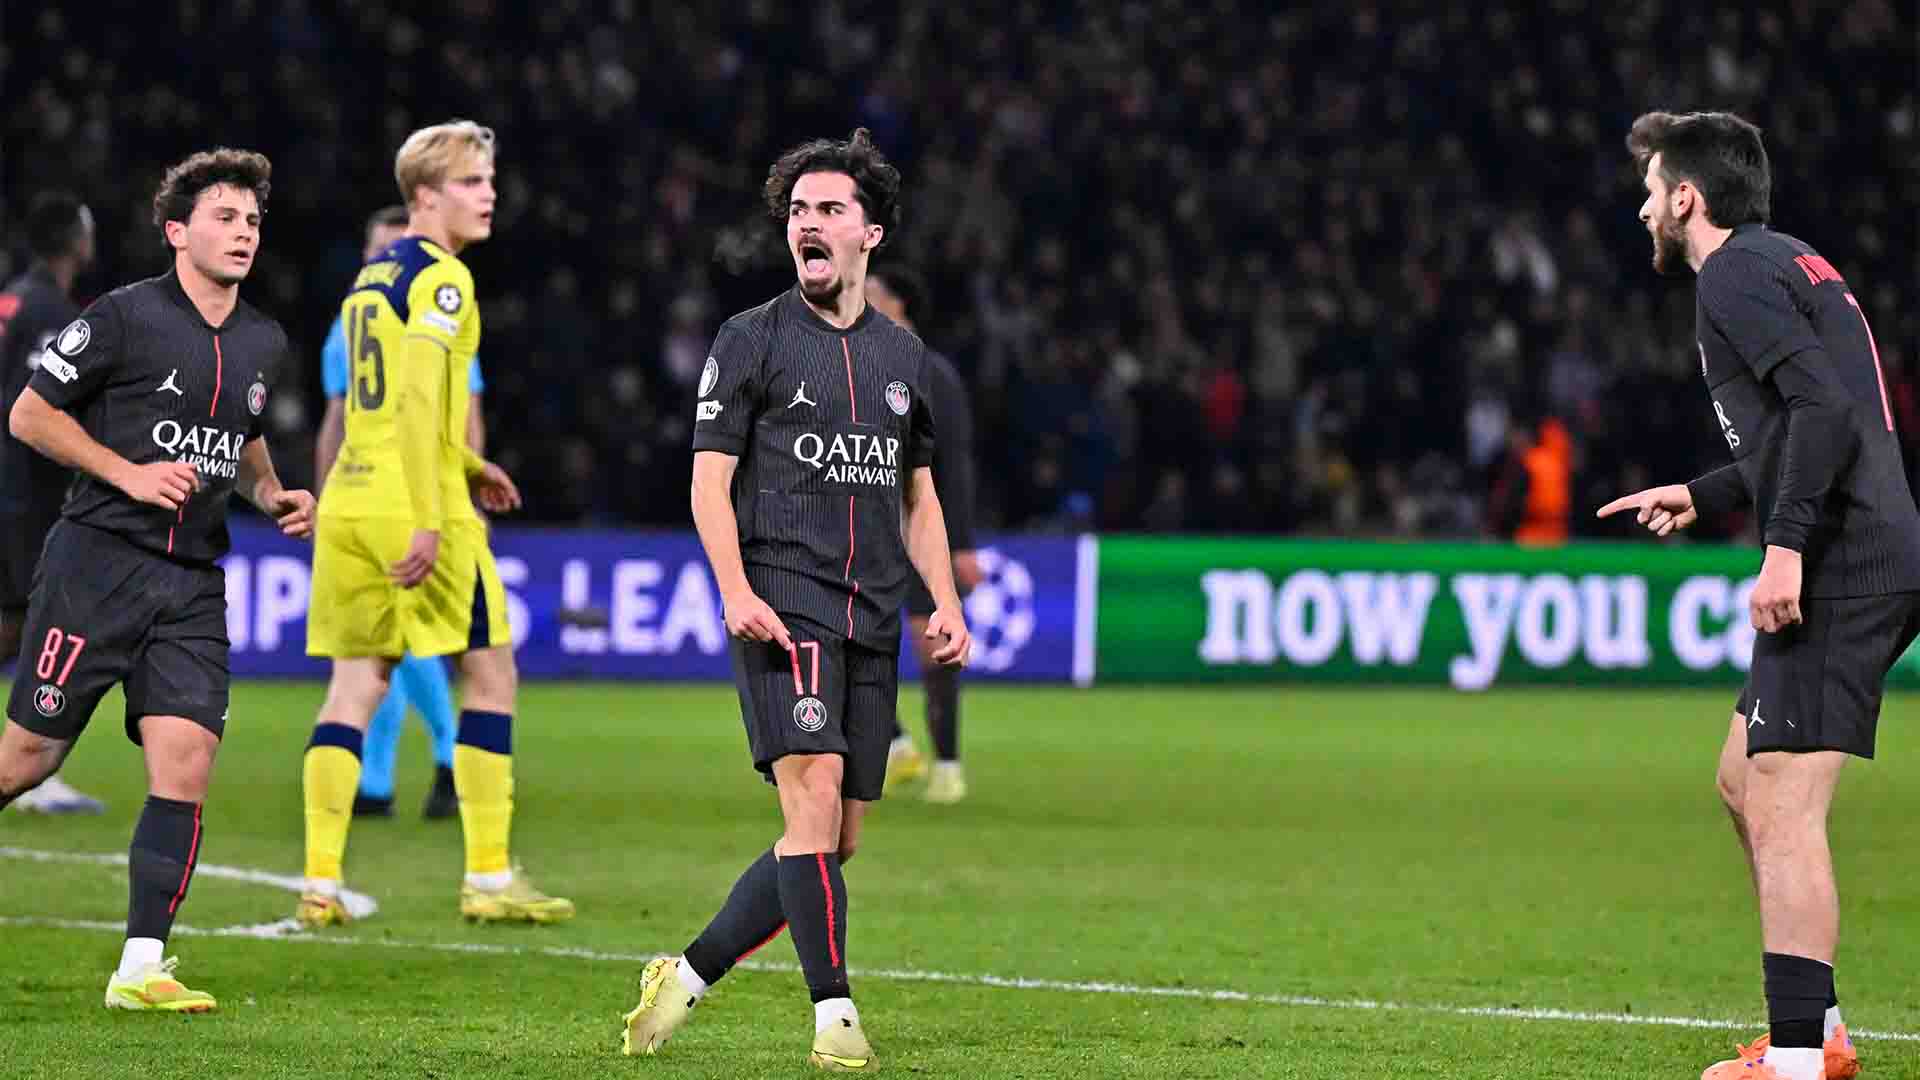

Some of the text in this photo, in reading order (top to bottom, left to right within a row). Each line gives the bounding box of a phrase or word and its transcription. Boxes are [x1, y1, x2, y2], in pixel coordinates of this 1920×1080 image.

[350, 303, 385, 413] 15
[152, 420, 244, 460] QATAR
[176, 452, 237, 479] AIRWAYS
[793, 433, 899, 469] QATAR
[823, 463, 897, 487] AIRWAYS
[561, 558, 727, 655] LEA
[1201, 569, 1436, 666] now
[1450, 573, 1652, 690] you
[37, 627, 86, 686] 87
[789, 641, 819, 696] 17
